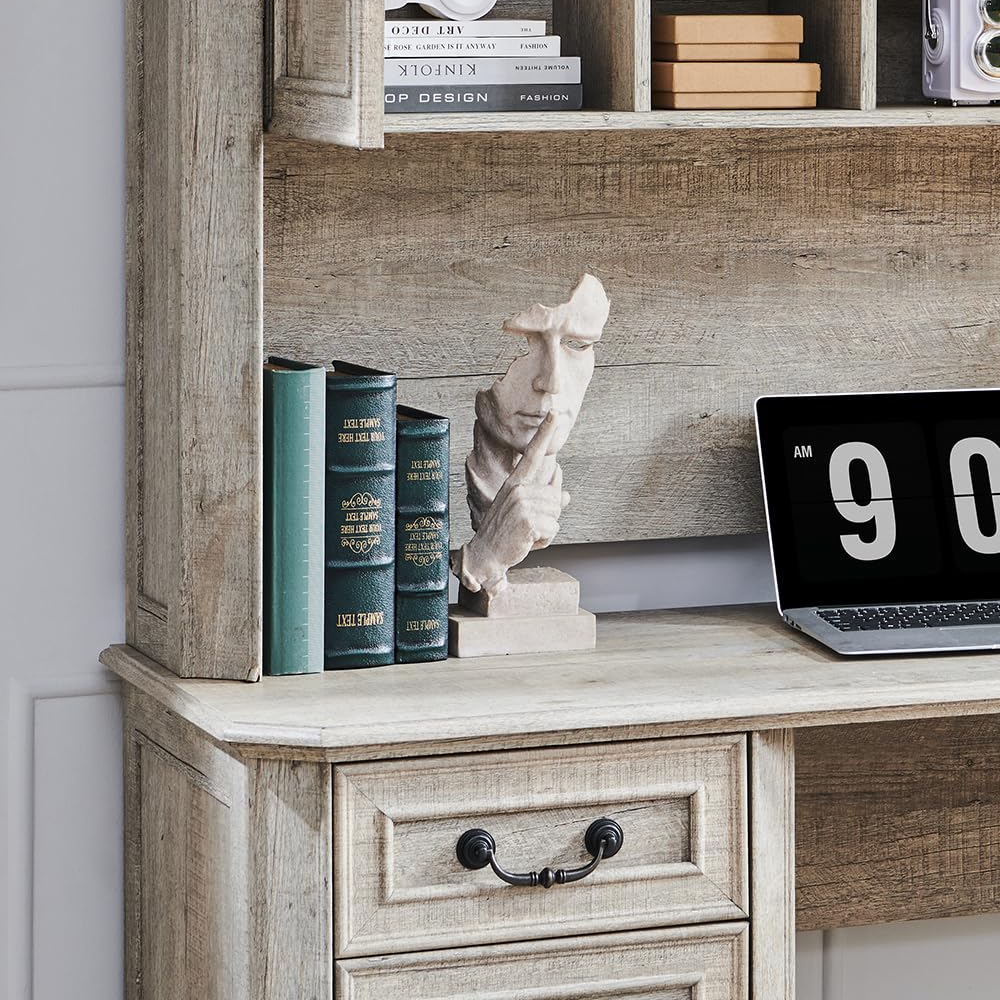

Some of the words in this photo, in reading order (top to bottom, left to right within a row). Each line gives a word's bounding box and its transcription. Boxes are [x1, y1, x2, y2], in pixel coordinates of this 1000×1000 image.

[391, 26, 430, 35] DECO
[437, 25, 464, 36] ART
[397, 63, 476, 77] KINFOLK
[384, 93, 409, 104] OP
[419, 92, 488, 103] DESIGN
[520, 94, 569, 102] FASHION
[343, 419, 359, 428] TEXT
[359, 418, 381, 428] SAMPLE
[338, 433, 354, 442] HERE
[355, 432, 369, 442] TEXT
[793, 445, 813, 459] AM
[828, 441, 897, 561] 9
[345, 513, 359, 521] TEXT
[359, 511, 379, 520] SAMPLE
[341, 525, 354, 534] HERE
[356, 525, 368, 533] TEXT
[336, 613, 356, 627] TEXT
[356, 612, 384, 628] SAMPLE
[406, 620, 419, 631] TEXT
[420, 620, 440, 631] SAMPLE
